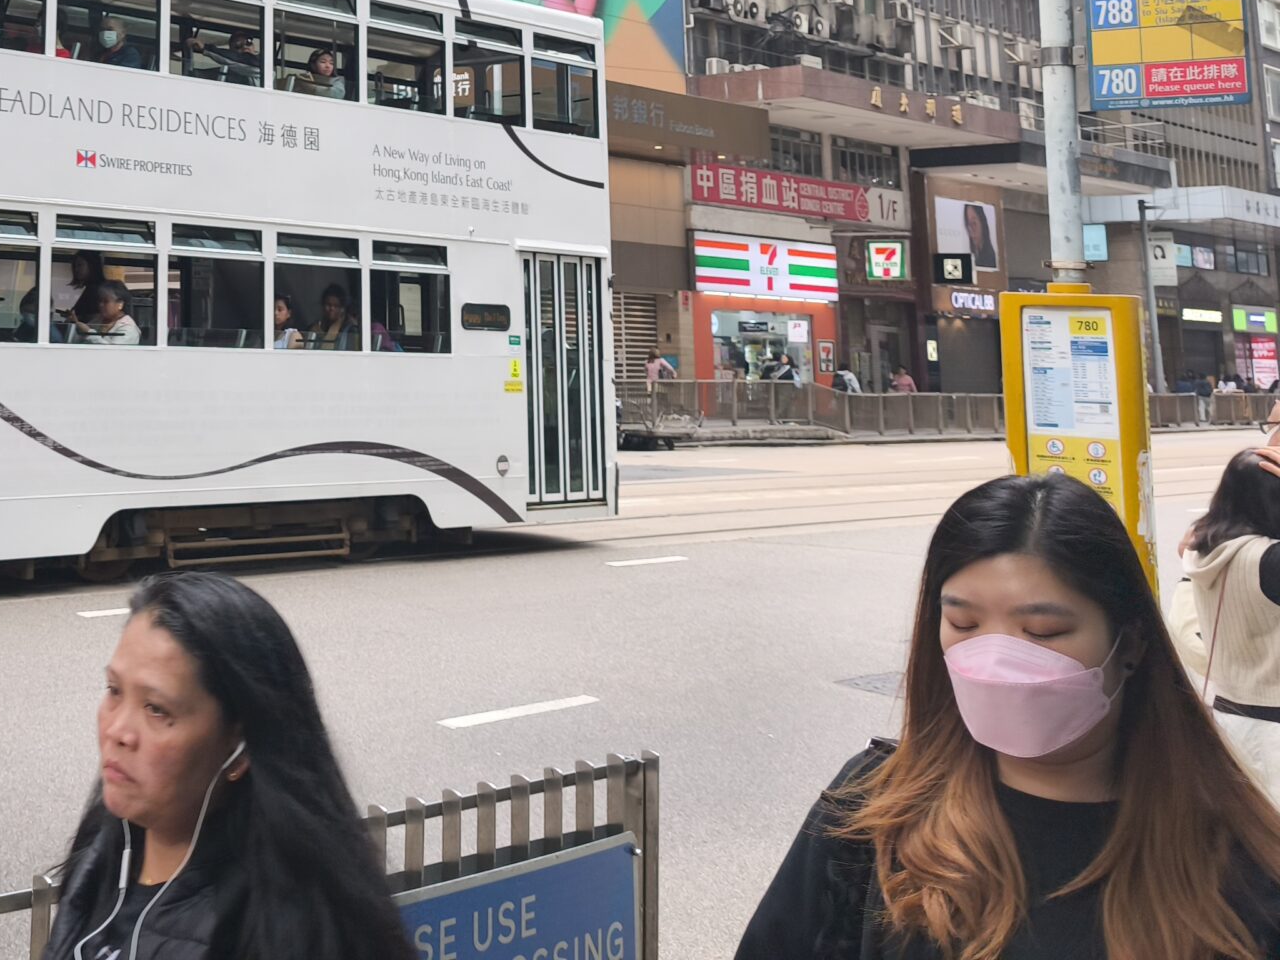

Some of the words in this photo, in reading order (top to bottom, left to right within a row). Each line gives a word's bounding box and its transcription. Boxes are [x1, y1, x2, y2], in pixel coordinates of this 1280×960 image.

[1099, 68, 1137, 95] 780
[1151, 64, 1238, 83] 請在此排隊
[1149, 83, 1180, 93] Please
[1184, 82, 1215, 92] queue
[1218, 80, 1242, 89] here
[1152, 95, 1235, 106] www.citybus.com.hk
[121, 103, 248, 142] RESIDENCES
[257, 120, 320, 152] 海德園
[133, 159, 192, 176] PROPERTIES
[372, 144, 381, 157] A
[384, 146, 406, 160] New
[408, 148, 429, 166] Way
[432, 151, 442, 165] of
[445, 153, 471, 172] Living
[474, 160, 486, 170] on
[373, 163, 400, 183] Hong
[404, 167, 428, 186] Kong
[431, 171, 463, 186] Island's
[466, 175, 484, 188] East
[696, 165, 800, 210] 中區捐血站
[878, 193, 898, 221] 1/F
[799, 183, 827, 198] CENTRAL
[822, 201, 846, 215] CENTRE
[1077, 320, 1099, 331] 780
[473, 894, 537, 952] USE
